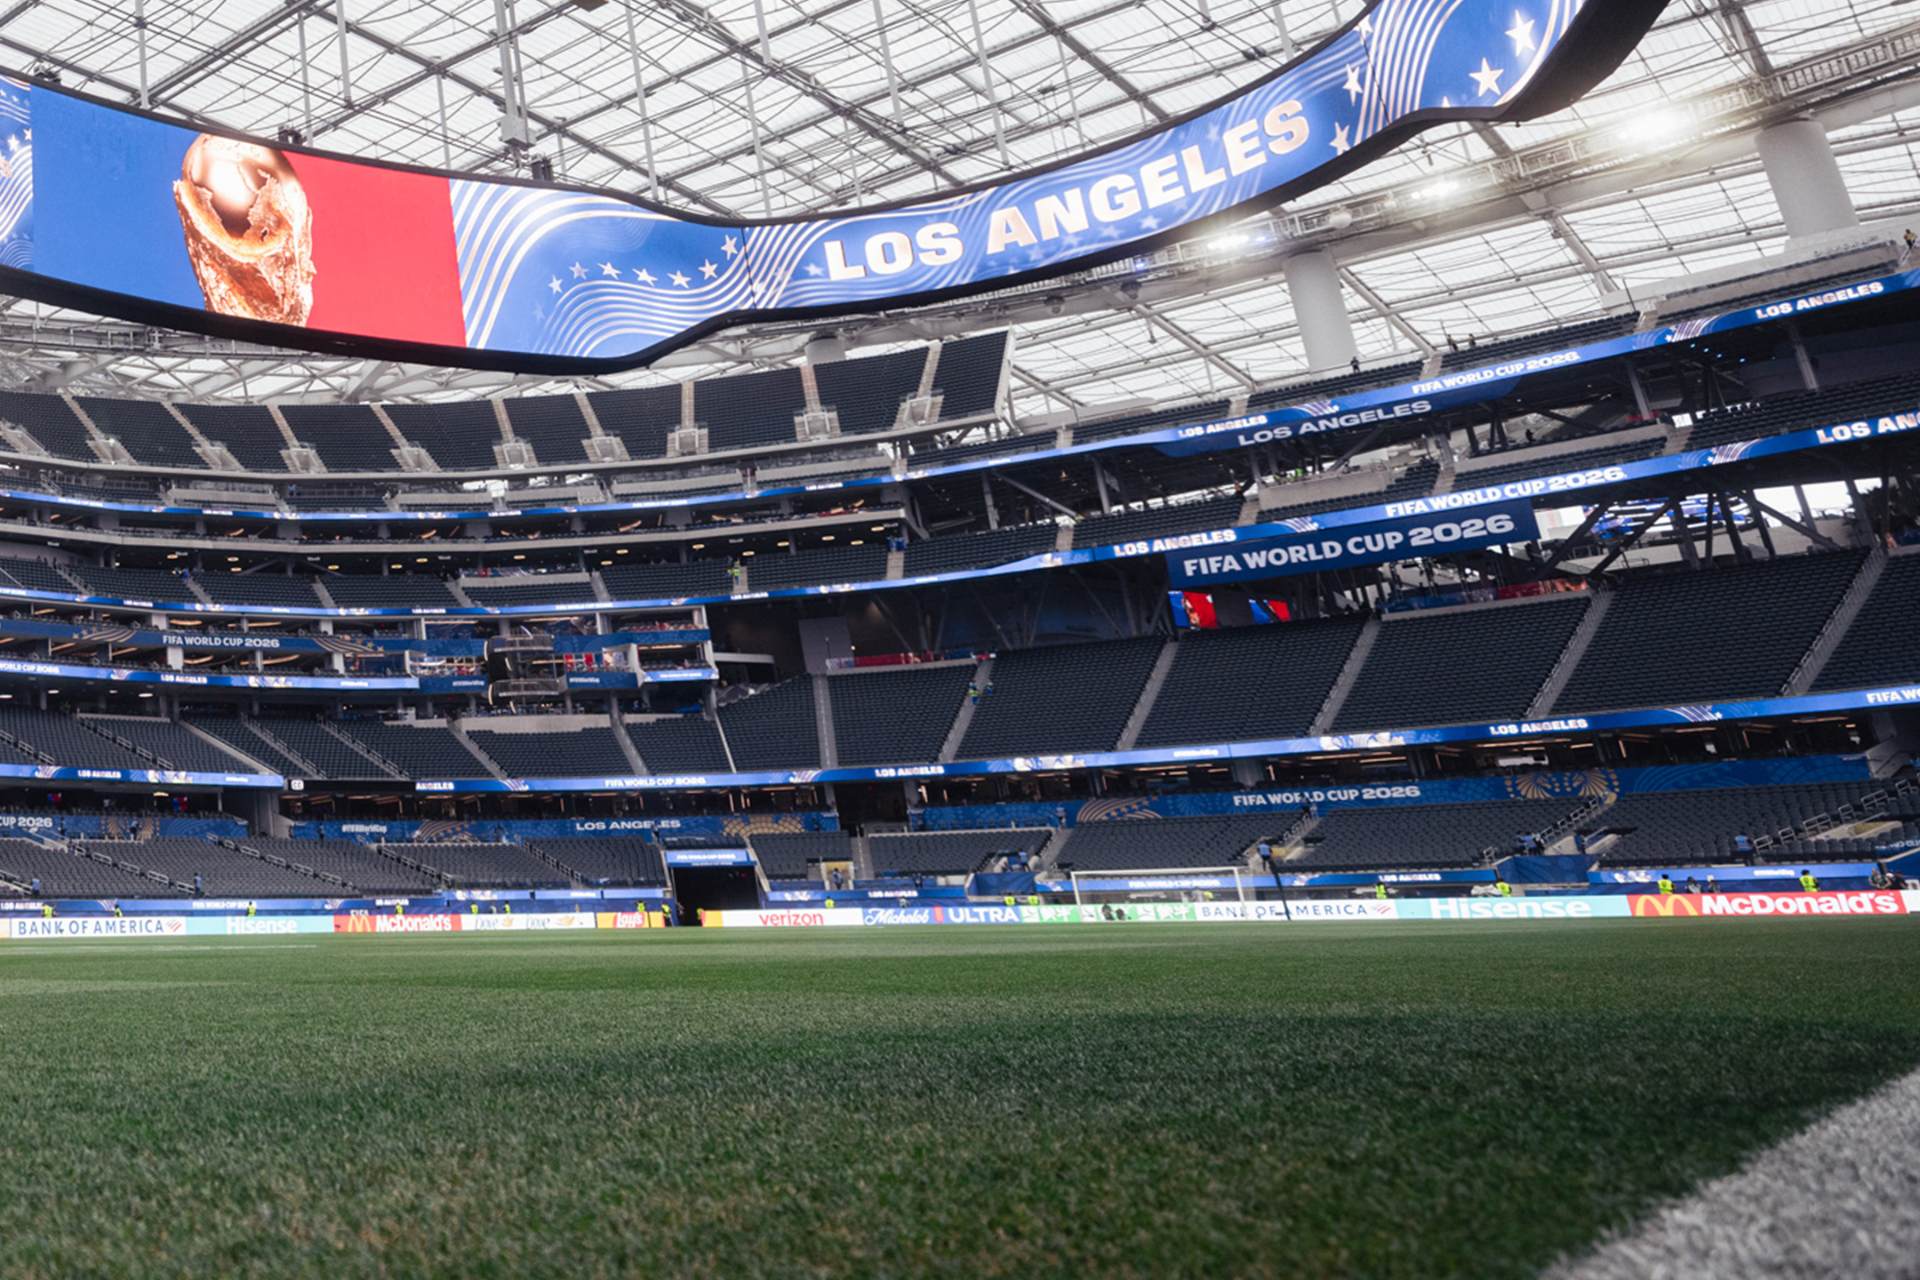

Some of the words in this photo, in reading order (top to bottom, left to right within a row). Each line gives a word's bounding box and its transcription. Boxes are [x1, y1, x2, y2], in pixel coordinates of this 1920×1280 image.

[824, 223, 964, 281] LOS
[985, 99, 1310, 255] ANGELES
[1755, 302, 1793, 319] LOS
[1796, 281, 1884, 310] ANGELES
[1412, 380, 1443, 394] FIFA
[1444, 369, 1494, 389] WORLD
[1496, 362, 1526, 377] CUP
[1526, 351, 1580, 370] 2026
[1178, 426, 1204, 438] LOS
[1205, 415, 1268, 434] ANGELES
[1238, 427, 1293, 446] LOS
[1299, 399, 1432, 435] ANGELES
[1816, 421, 1872, 444] LOS
[1877, 411, 1920, 434] AN
[1385, 502, 1430, 518] FIFA
[1430, 486, 1502, 511] WORLD
[1504, 478, 1546, 498] CUP
[1549, 467, 1625, 490] 2026
[1113, 541, 1150, 557] LOS
[1151, 529, 1237, 552] ANGELES
[1183, 554, 1242, 576] FIFA
[1244, 540, 1343, 569] WORLD
[1347, 531, 1405, 555] CUP
[1408, 514, 1515, 547] 2026
[162, 635, 184, 645] FIFA
[184, 636, 222, 646] WORLD
[223, 637, 244, 647] CUP
[244, 638, 280, 648] 2026
[1865, 691, 1902, 704] FIFA
[1489, 724, 1519, 736] LOS
[1521, 718, 1588, 734] ANGELES
[656, 778, 674, 786] CUP
[874, 767, 896, 778] LOS
[897, 765, 945, 777] ANGELES
[1233, 794, 1267, 807] FIFA
[1327, 788, 1359, 802] CUP
[1362, 785, 1421, 800] 2026
[18, 817, 53, 828] 2026
[576, 821, 606, 831] LOS
[1429, 897, 1592, 919] Hisense
[1702, 892, 1899, 915] McDonald's
[226, 914, 297, 935] Hisense
[376, 914, 452, 932] McDonald's
[759, 909, 824, 927] verizon
[864, 908, 929, 926] Michelob
[948, 907, 1019, 923] ULTRA
[18, 921, 64, 935] BANK
[69, 920, 88, 934] OF
[93, 918, 164, 934] AMERICA
